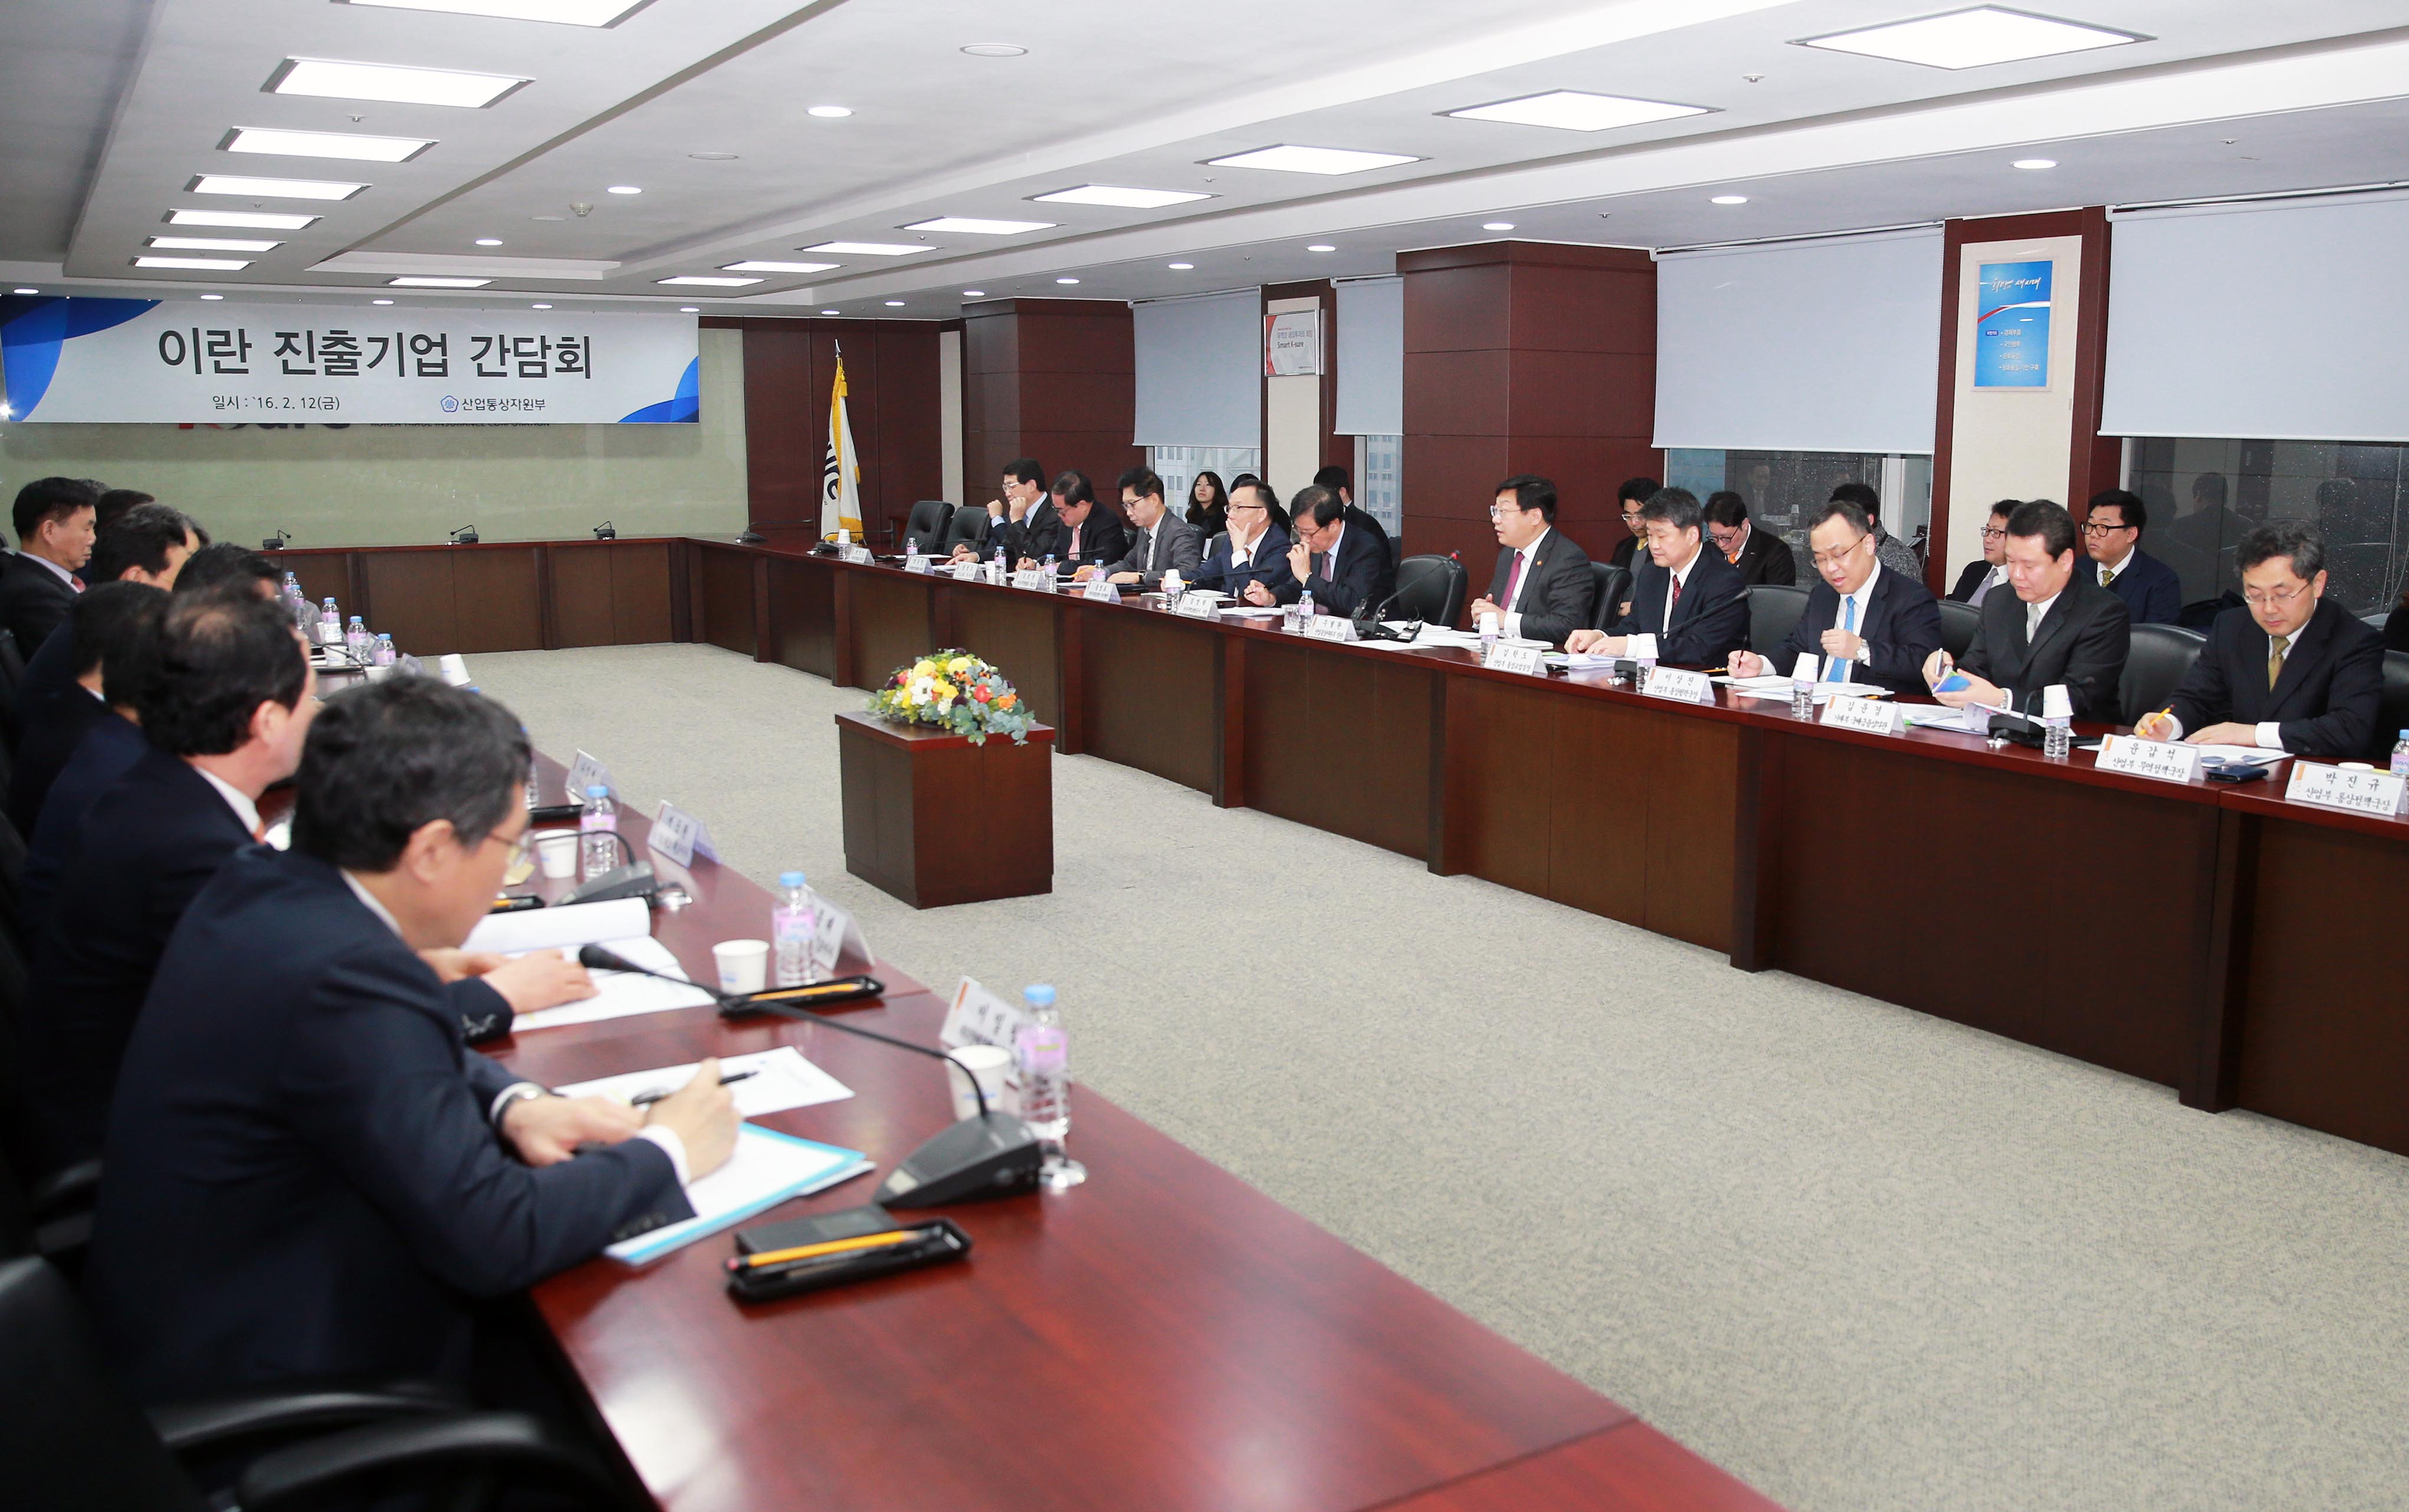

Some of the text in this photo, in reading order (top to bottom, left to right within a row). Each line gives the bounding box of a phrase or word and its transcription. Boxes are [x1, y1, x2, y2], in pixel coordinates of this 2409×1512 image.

[159, 328, 591, 379] 이란 진출기업 간담회
[212, 395, 239, 410] 일시
[301, 396, 340, 411] 12(금)
[462, 398, 546, 412] 산업통상자원부
[2113, 757, 2185, 778] 산업부 무역정책국장
[2305, 787, 2391, 811] 산업부 통상정책국장
